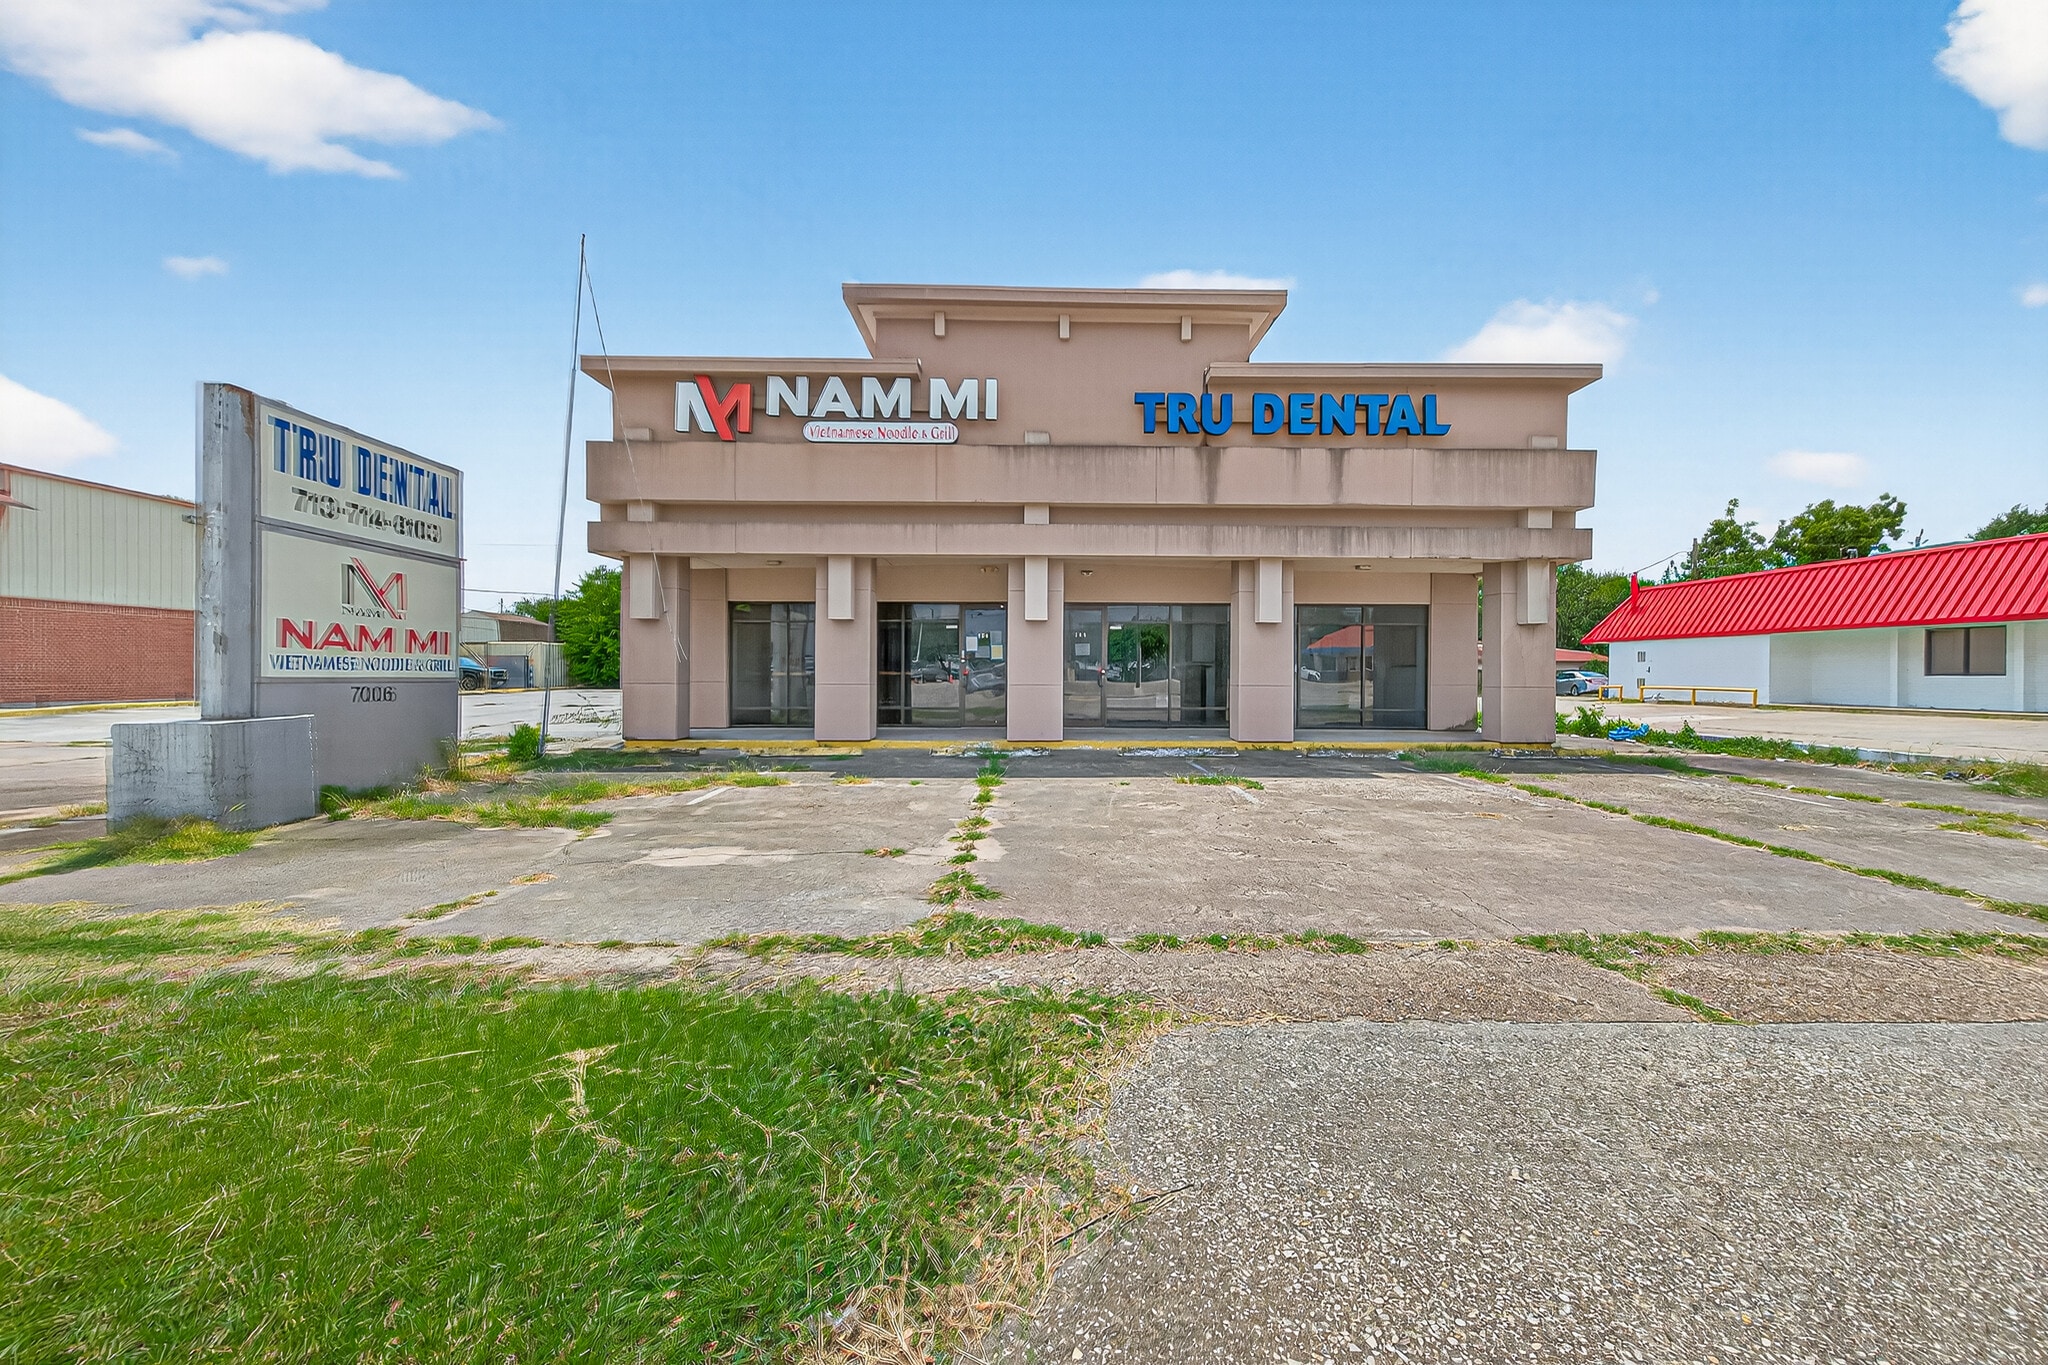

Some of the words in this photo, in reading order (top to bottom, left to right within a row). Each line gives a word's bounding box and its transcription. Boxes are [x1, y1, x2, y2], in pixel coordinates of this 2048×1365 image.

[765, 375, 912, 419] NAM
[928, 377, 998, 420] MI
[1134, 392, 1233, 435] TRU
[1251, 392, 1452, 436] DENTAL
[807, 424, 874, 439] Vietnamese
[877, 425, 918, 439] Noodle
[930, 426, 955, 440] Grill
[268, 415, 345, 488] TRU
[352, 445, 455, 519] DENTAL
[276, 617, 397, 653] NAM
[405, 628, 452, 655] MI
[269, 653, 359, 670] VIETNAMESE
[426, 659, 456, 672] GRILL
[350, 686, 398, 703] 7006
